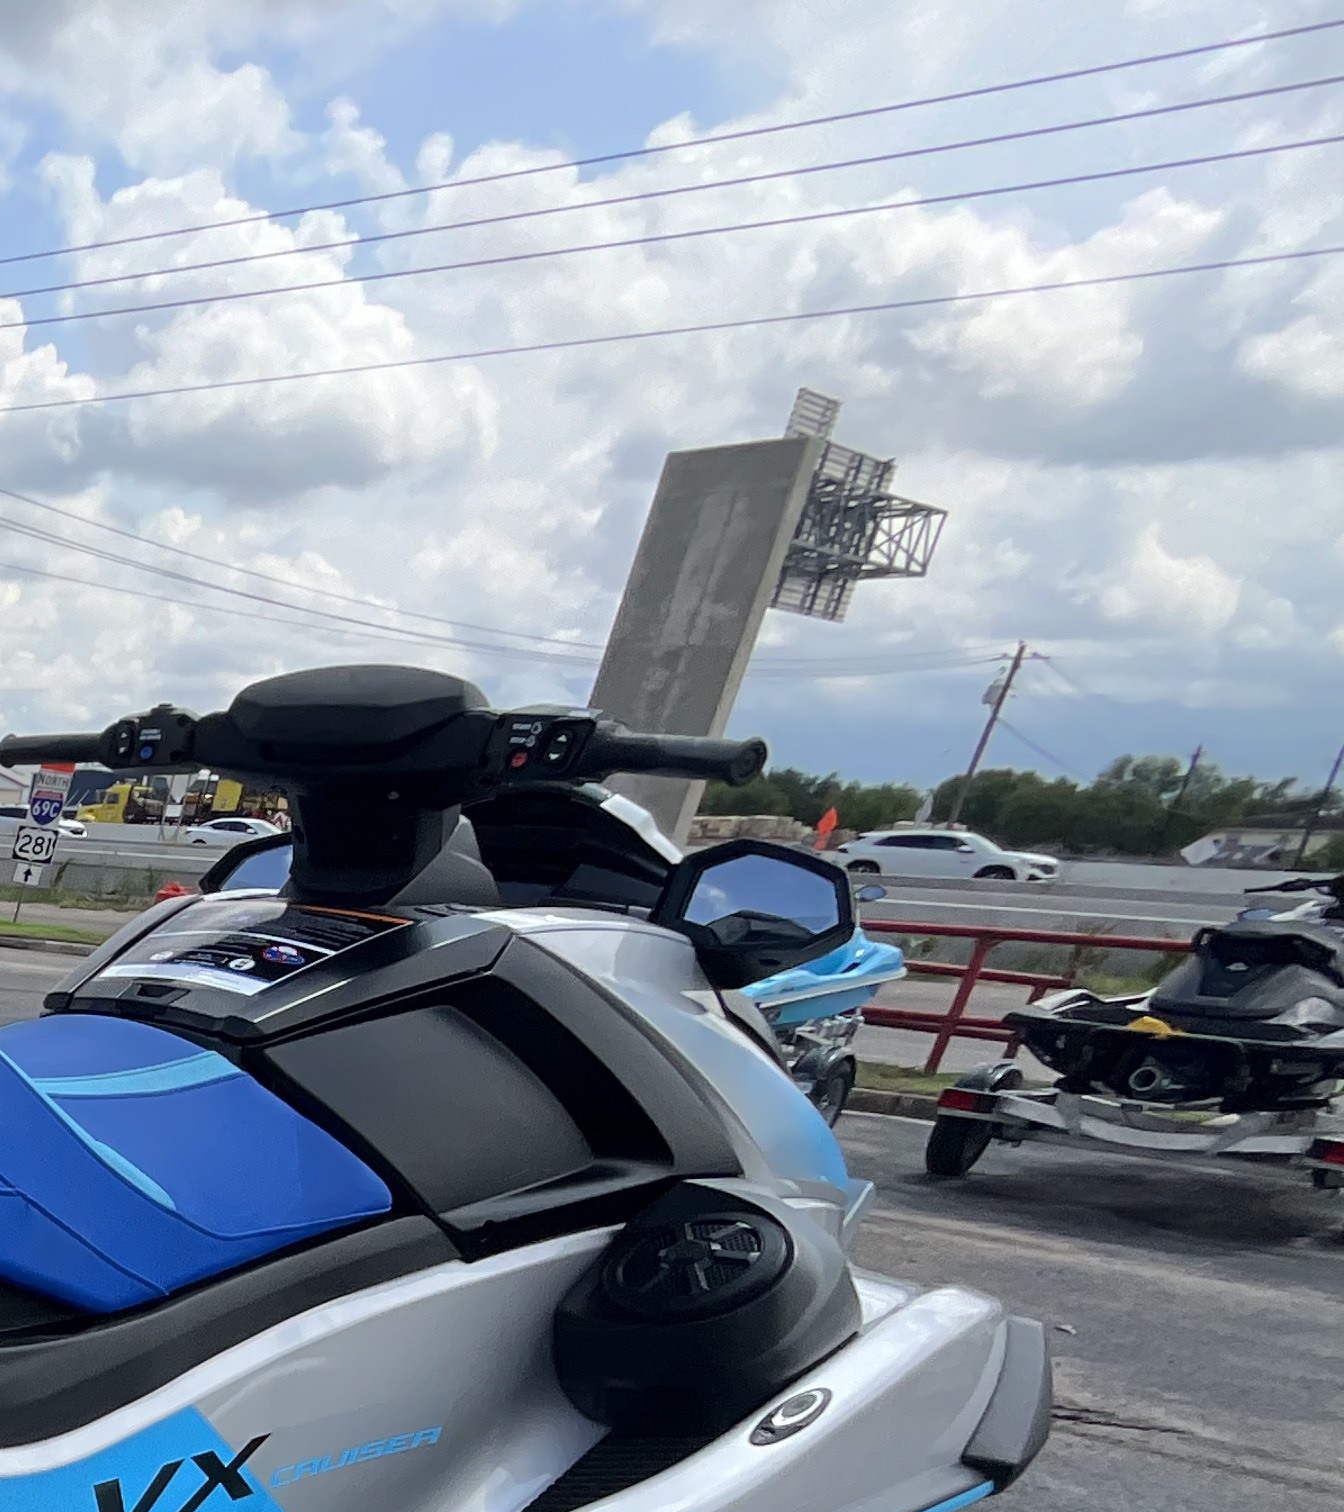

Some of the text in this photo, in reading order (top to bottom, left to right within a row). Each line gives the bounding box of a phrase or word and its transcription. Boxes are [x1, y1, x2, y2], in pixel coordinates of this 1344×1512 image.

[36, 773, 69, 788] NORTH
[32, 800, 61, 818] 69C
[17, 834, 52, 857] 281
[269, 1426, 443, 1488] CRUISER
